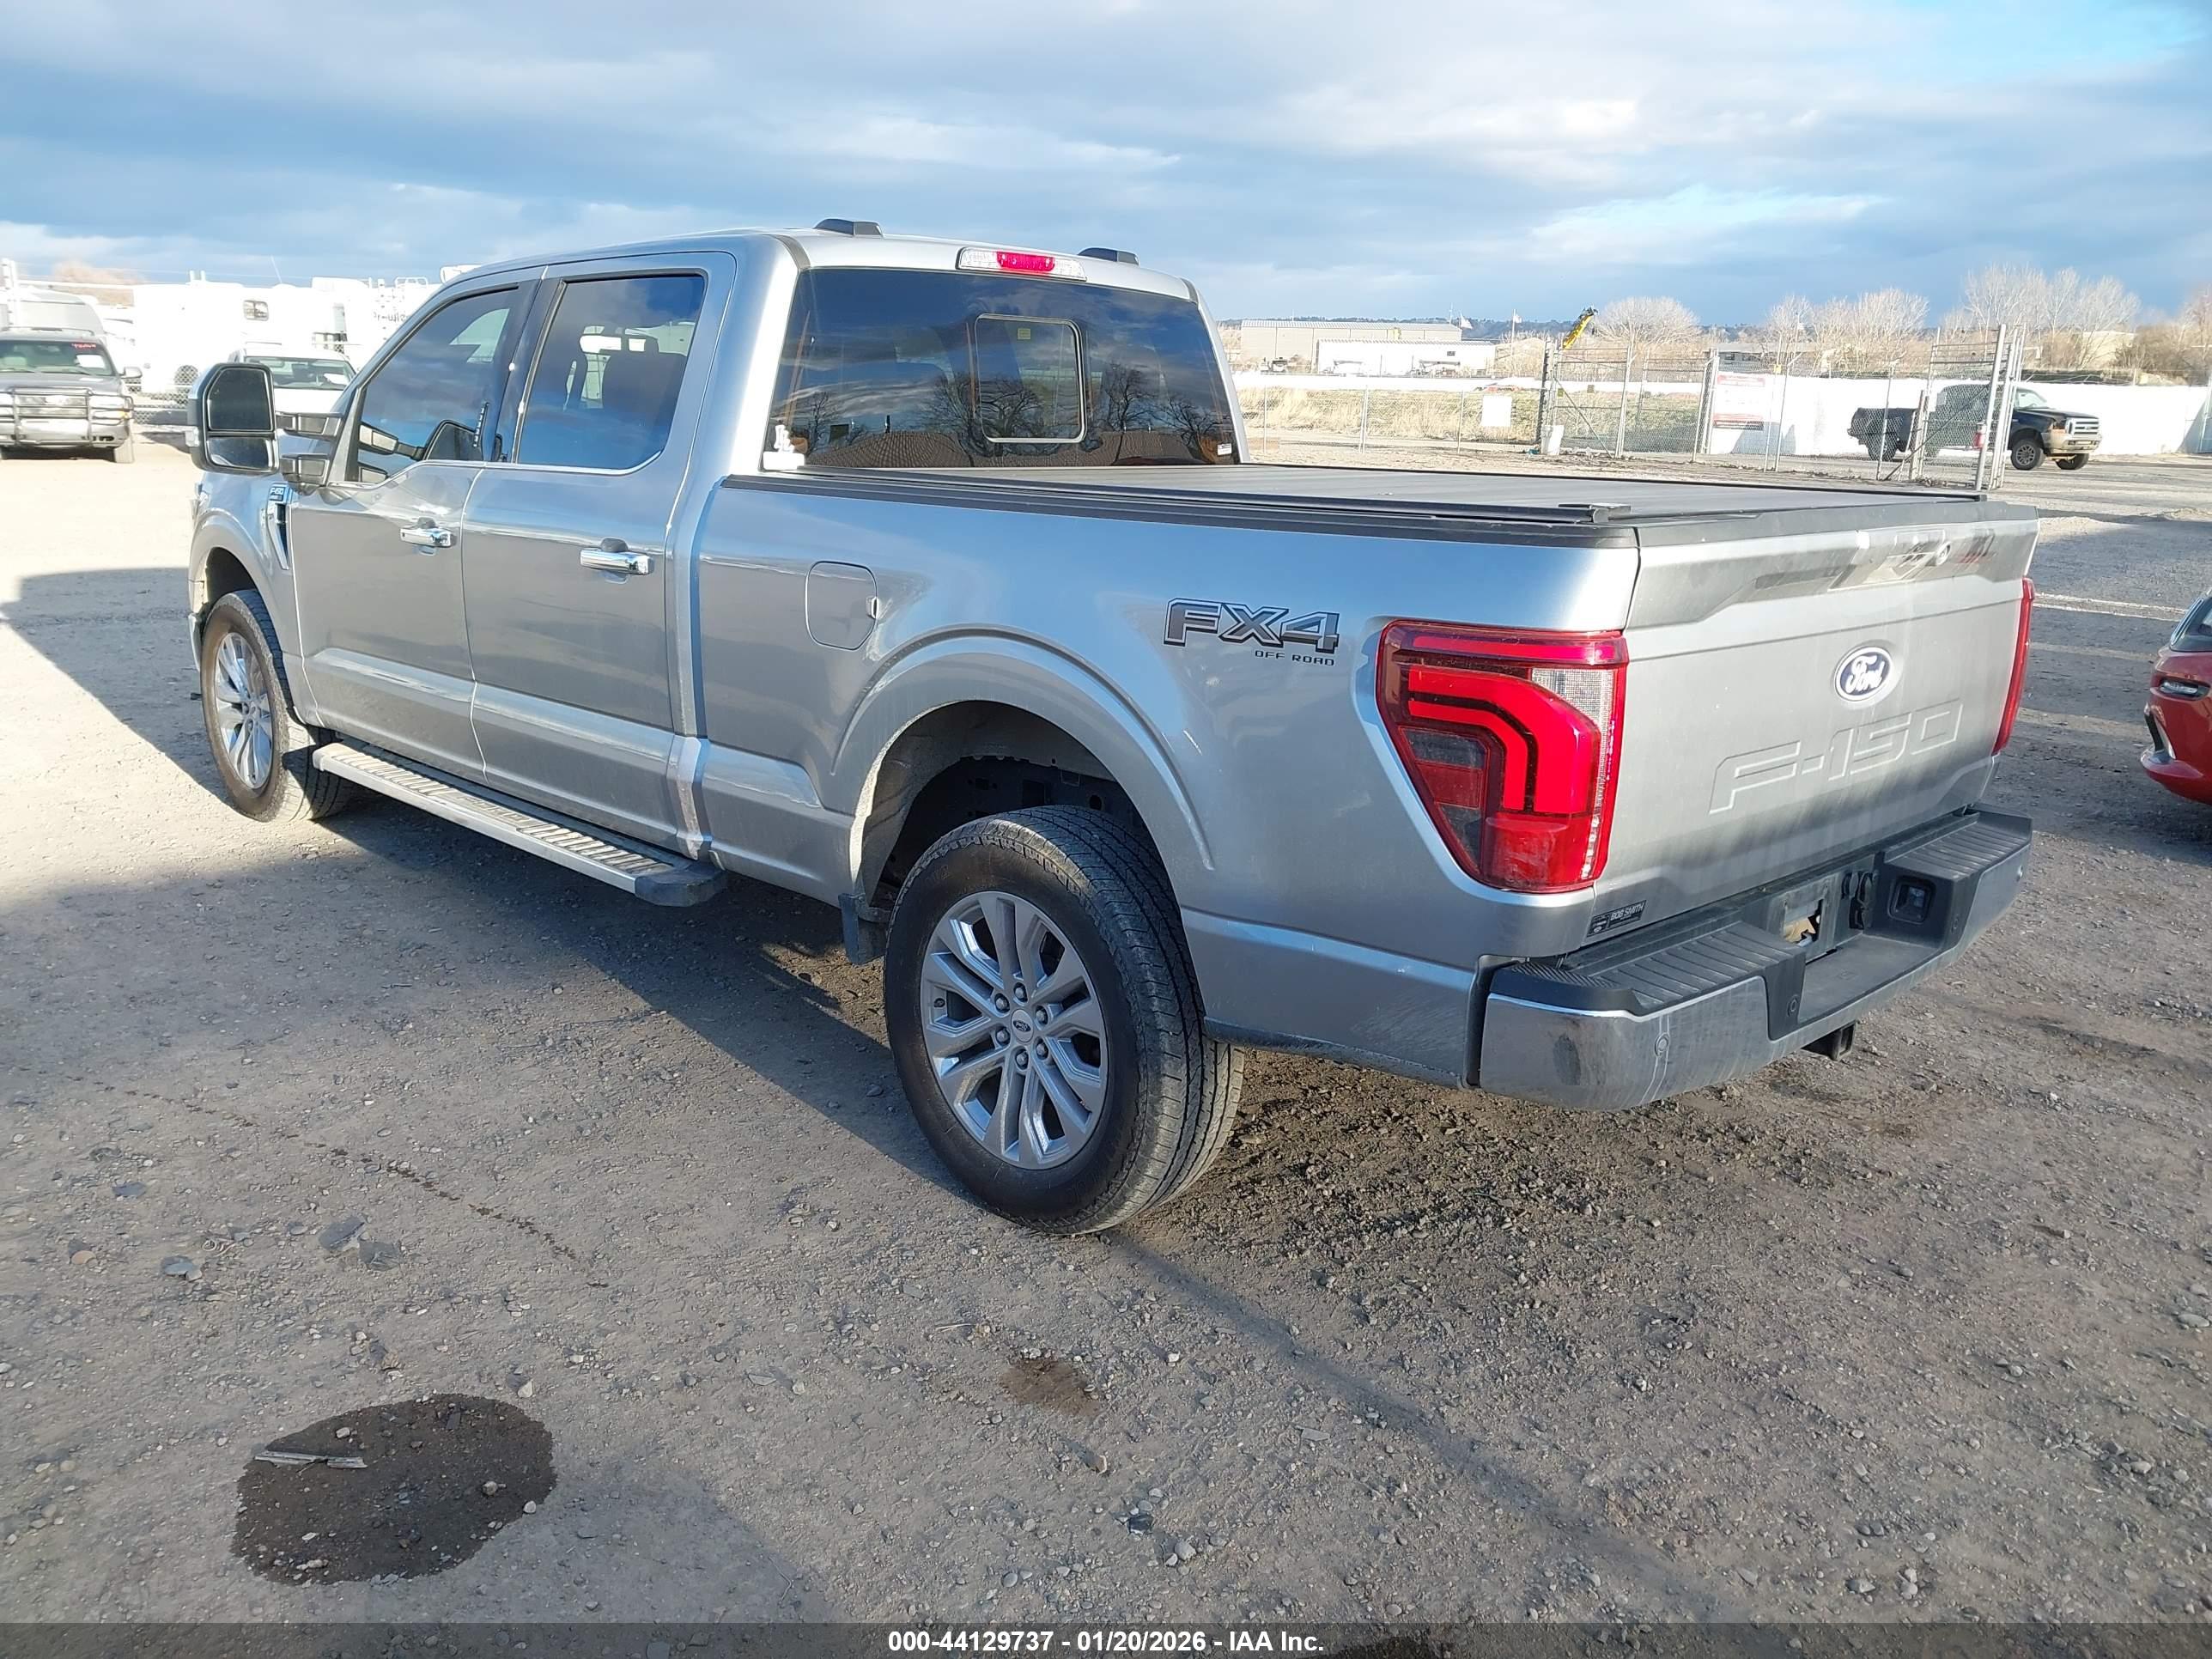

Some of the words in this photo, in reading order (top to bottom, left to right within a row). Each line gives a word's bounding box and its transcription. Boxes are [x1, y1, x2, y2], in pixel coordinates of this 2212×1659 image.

[1164, 598, 1340, 654] FX4
[1255, 650, 1285, 659] OFF
[1291, 654, 1335, 666] ROAD
[1844, 654, 1886, 694] Ford
[1709, 698, 1964, 815] F-150
